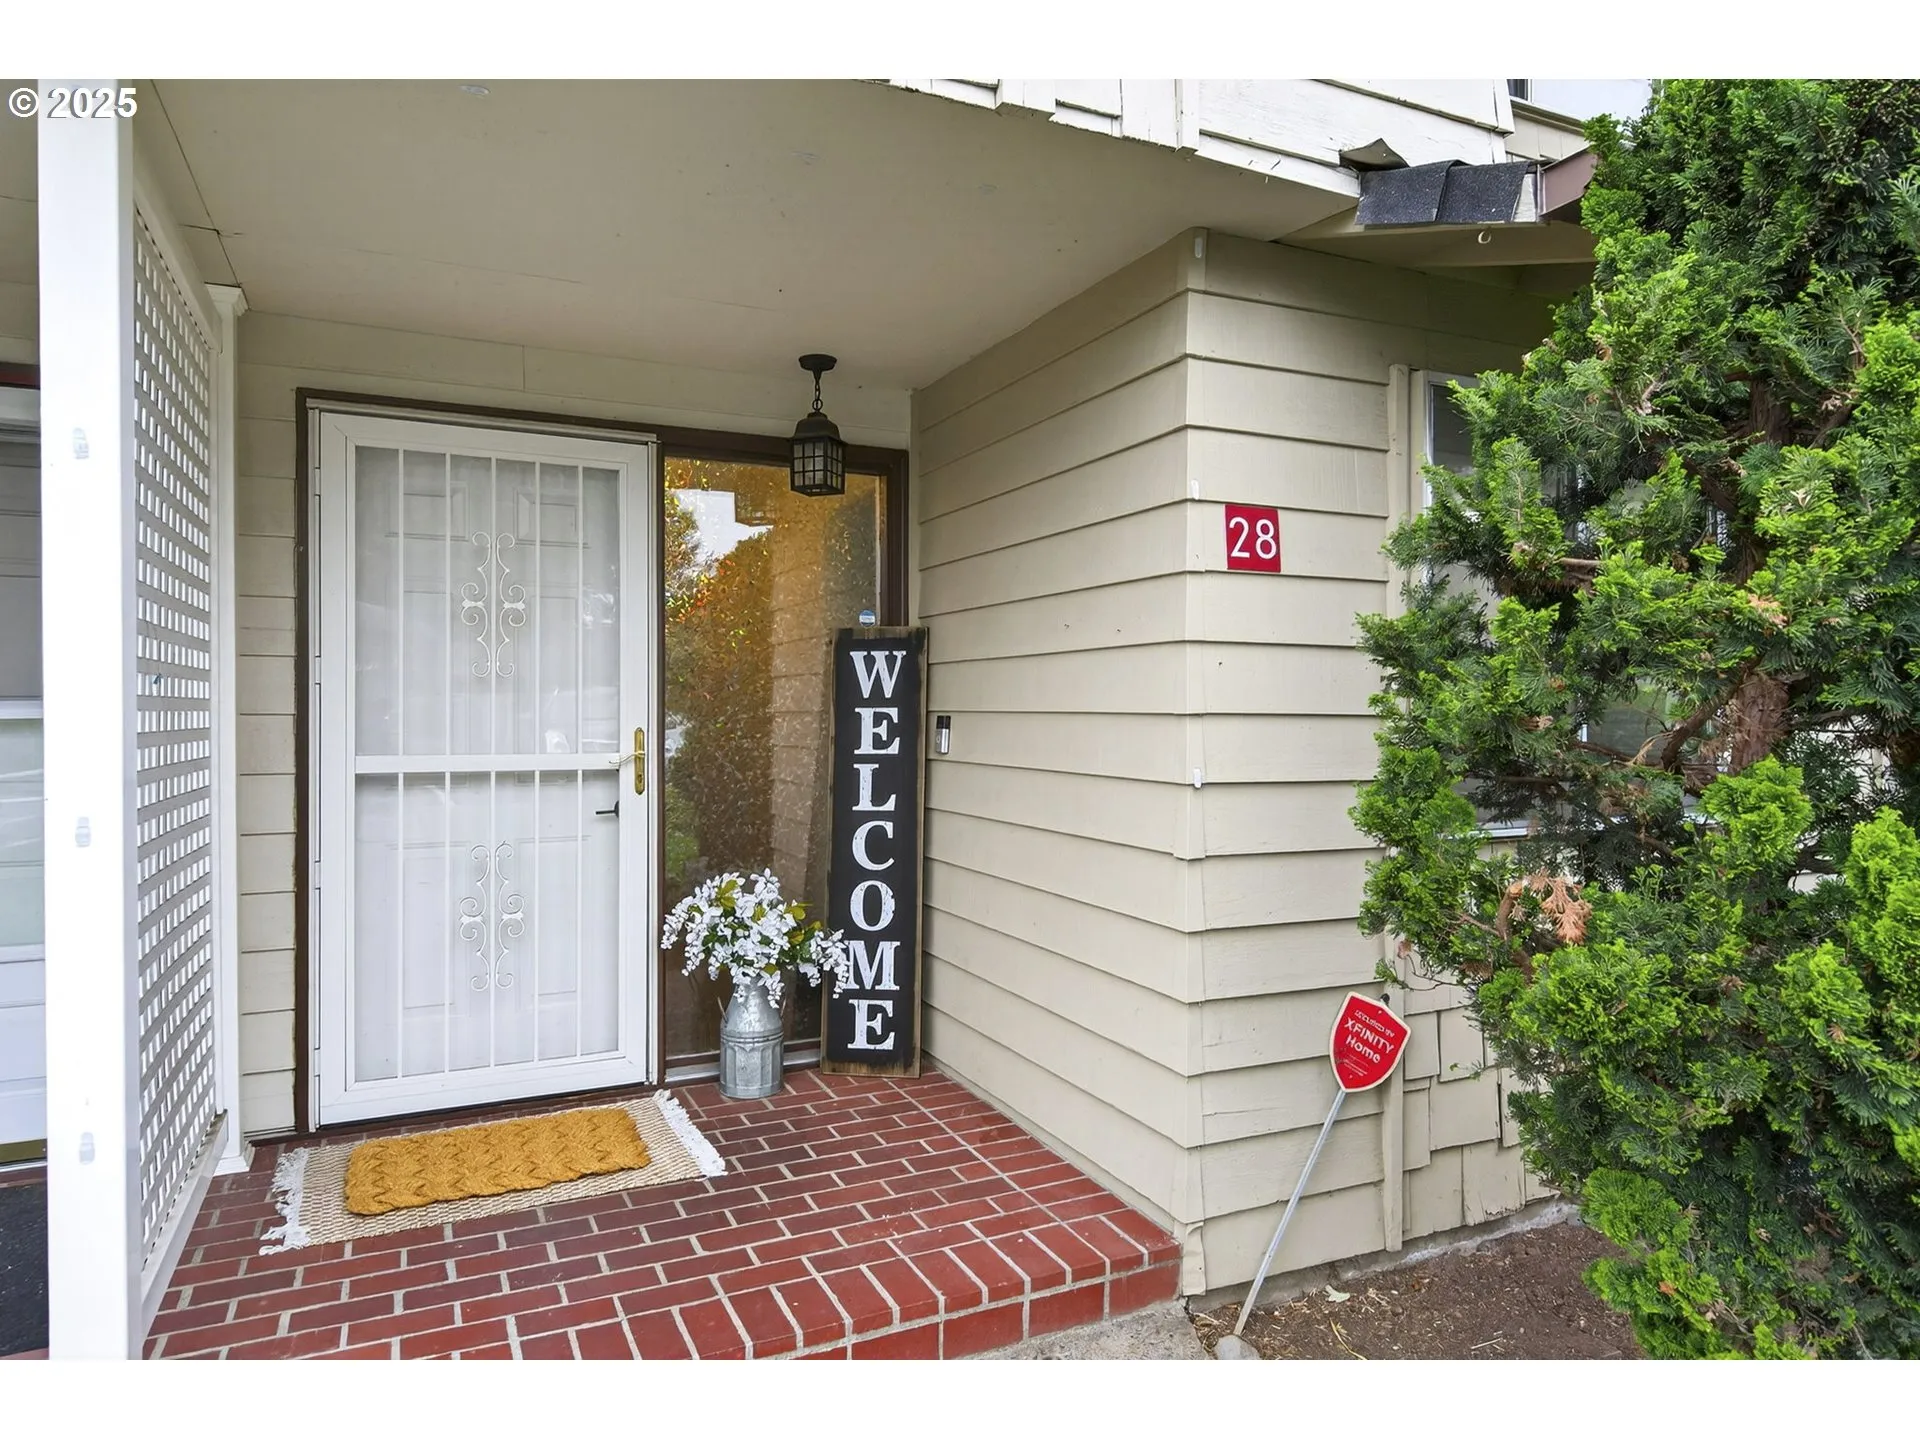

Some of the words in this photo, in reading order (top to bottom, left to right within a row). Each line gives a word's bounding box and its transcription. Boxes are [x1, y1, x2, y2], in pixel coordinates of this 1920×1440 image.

[1229, 516, 1277, 560] 28
[847, 650, 907, 1051] WELCOME
[1344, 1017, 1394, 1054] XFINITY
[1346, 1034, 1381, 1064] Home
